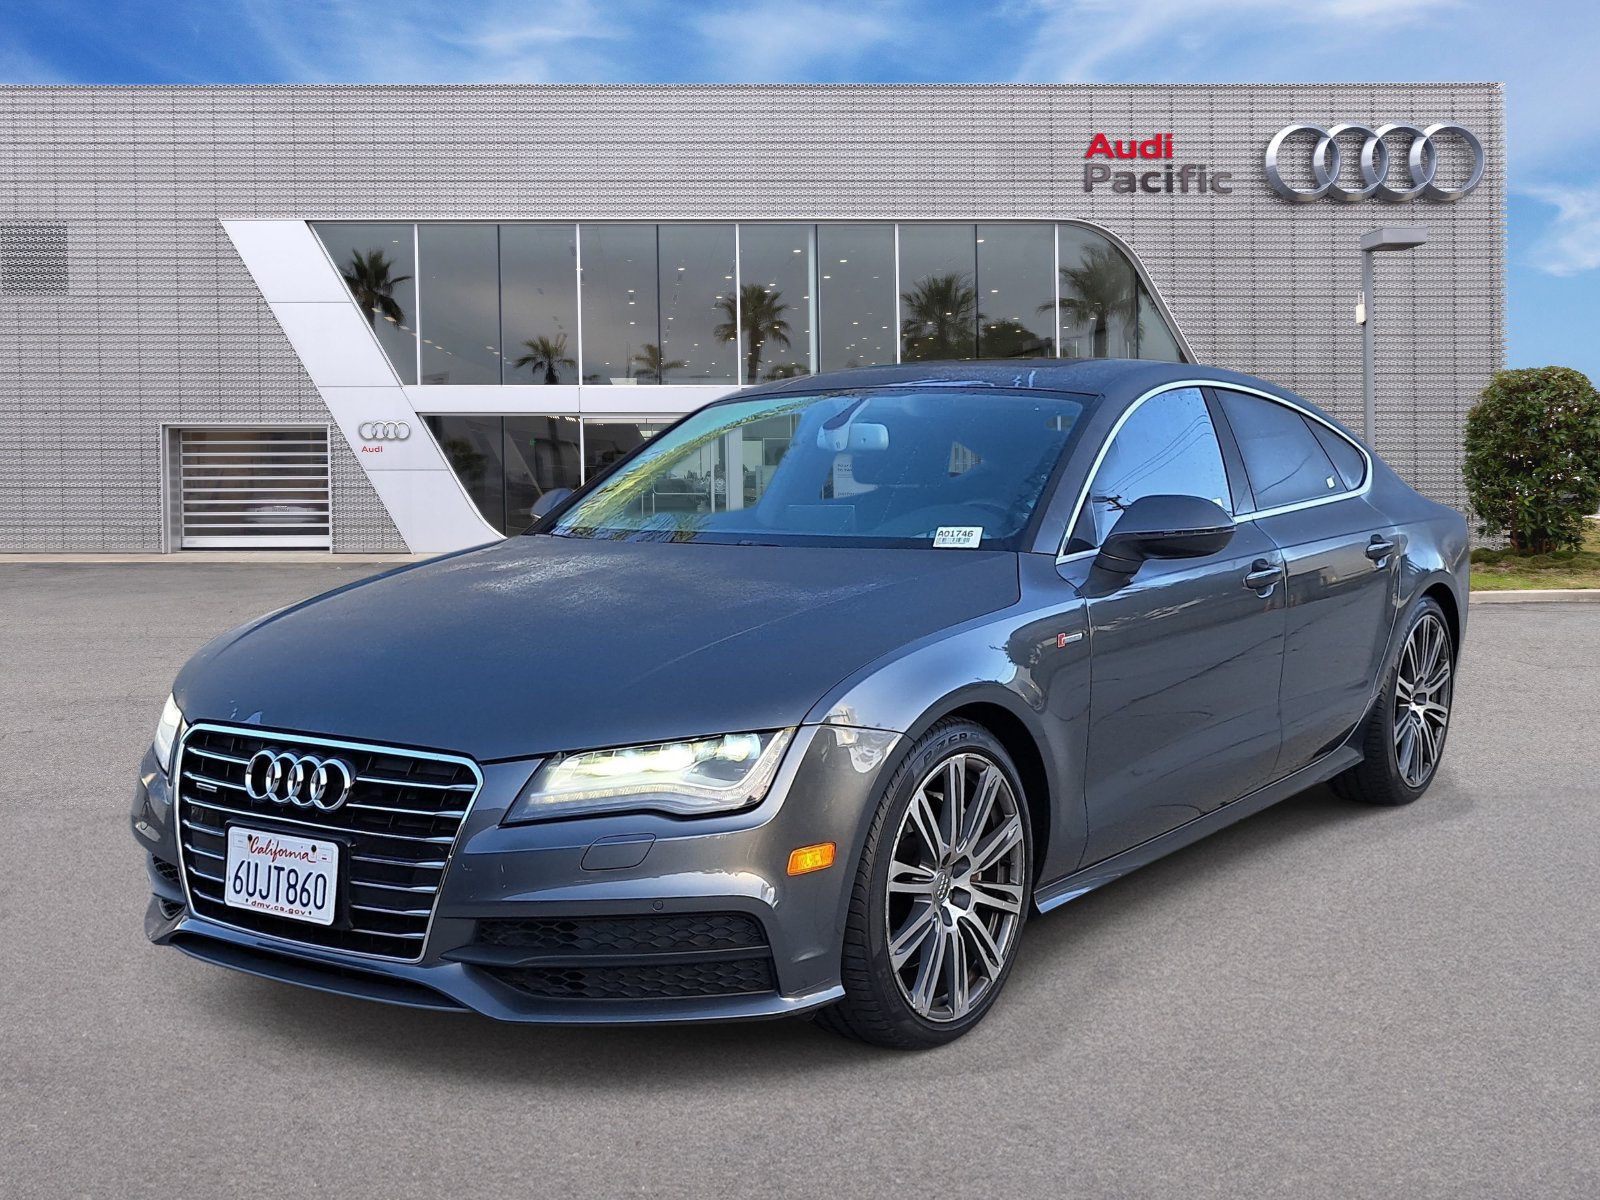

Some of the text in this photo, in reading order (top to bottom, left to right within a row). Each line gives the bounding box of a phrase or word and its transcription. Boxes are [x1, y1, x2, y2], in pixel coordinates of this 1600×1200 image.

[1084, 132, 1173, 159] Audi
[1084, 163, 1233, 194] Pacific
[361, 445, 383, 453] Audi
[937, 530, 974, 538] A01746
[249, 836, 317, 864] California
[232, 860, 327, 911] 6UJT860
[250, 900, 306, 916] dmv.ca.gov
